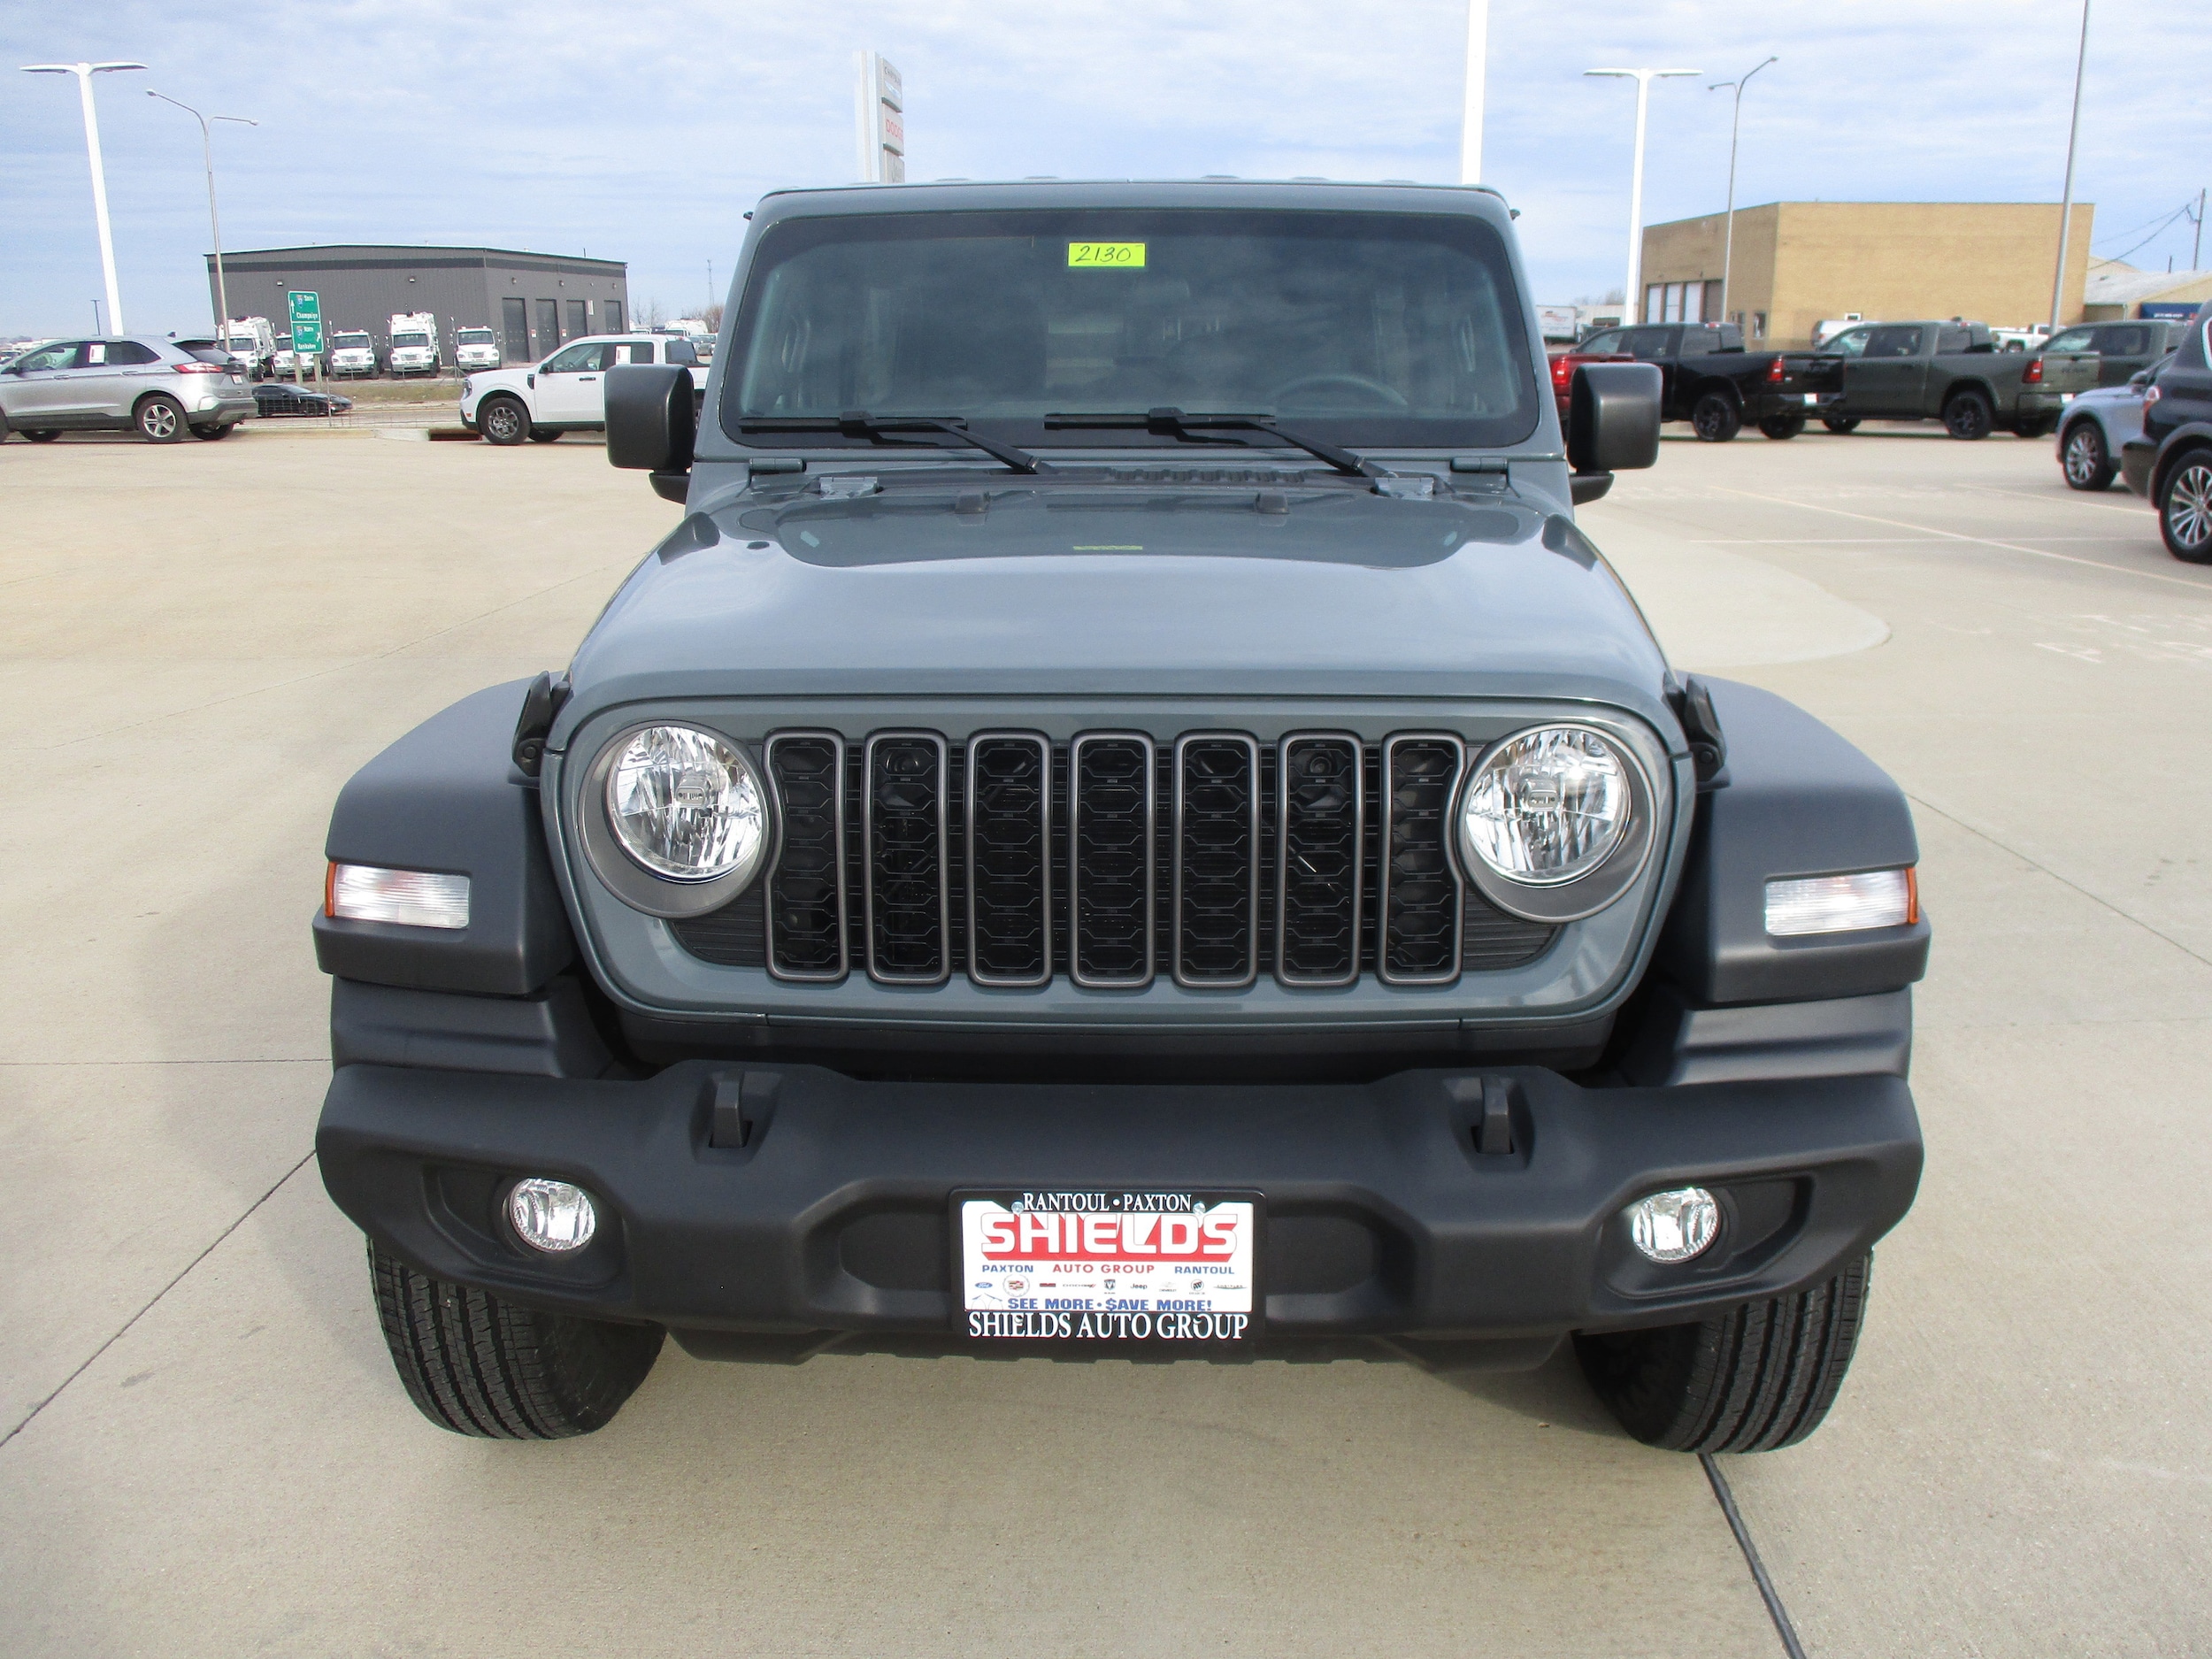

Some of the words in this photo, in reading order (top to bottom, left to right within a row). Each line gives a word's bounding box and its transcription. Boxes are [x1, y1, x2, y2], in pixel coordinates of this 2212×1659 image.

[1075, 245, 1131, 262] 2130
[1023, 1193, 1109, 1211] RANTOUL
[1123, 1194, 1192, 1212] PAXTON
[980, 1212, 1239, 1262] SHIELDS
[981, 1264, 1033, 1273] PAXTON
[1053, 1264, 1094, 1274] AUTO
[1101, 1264, 1156, 1274] GROUP
[1174, 1265, 1235, 1275] RANTOUL
[1008, 1298, 1039, 1310] SEE
[1045, 1299, 1094, 1310] MORE
[1156, 1299, 1212, 1311] MORE!
[968, 1311, 1071, 1339] SHIELDS
[1076, 1312, 1152, 1339] AUTO
[1156, 1313, 1248, 1340] GROUP
